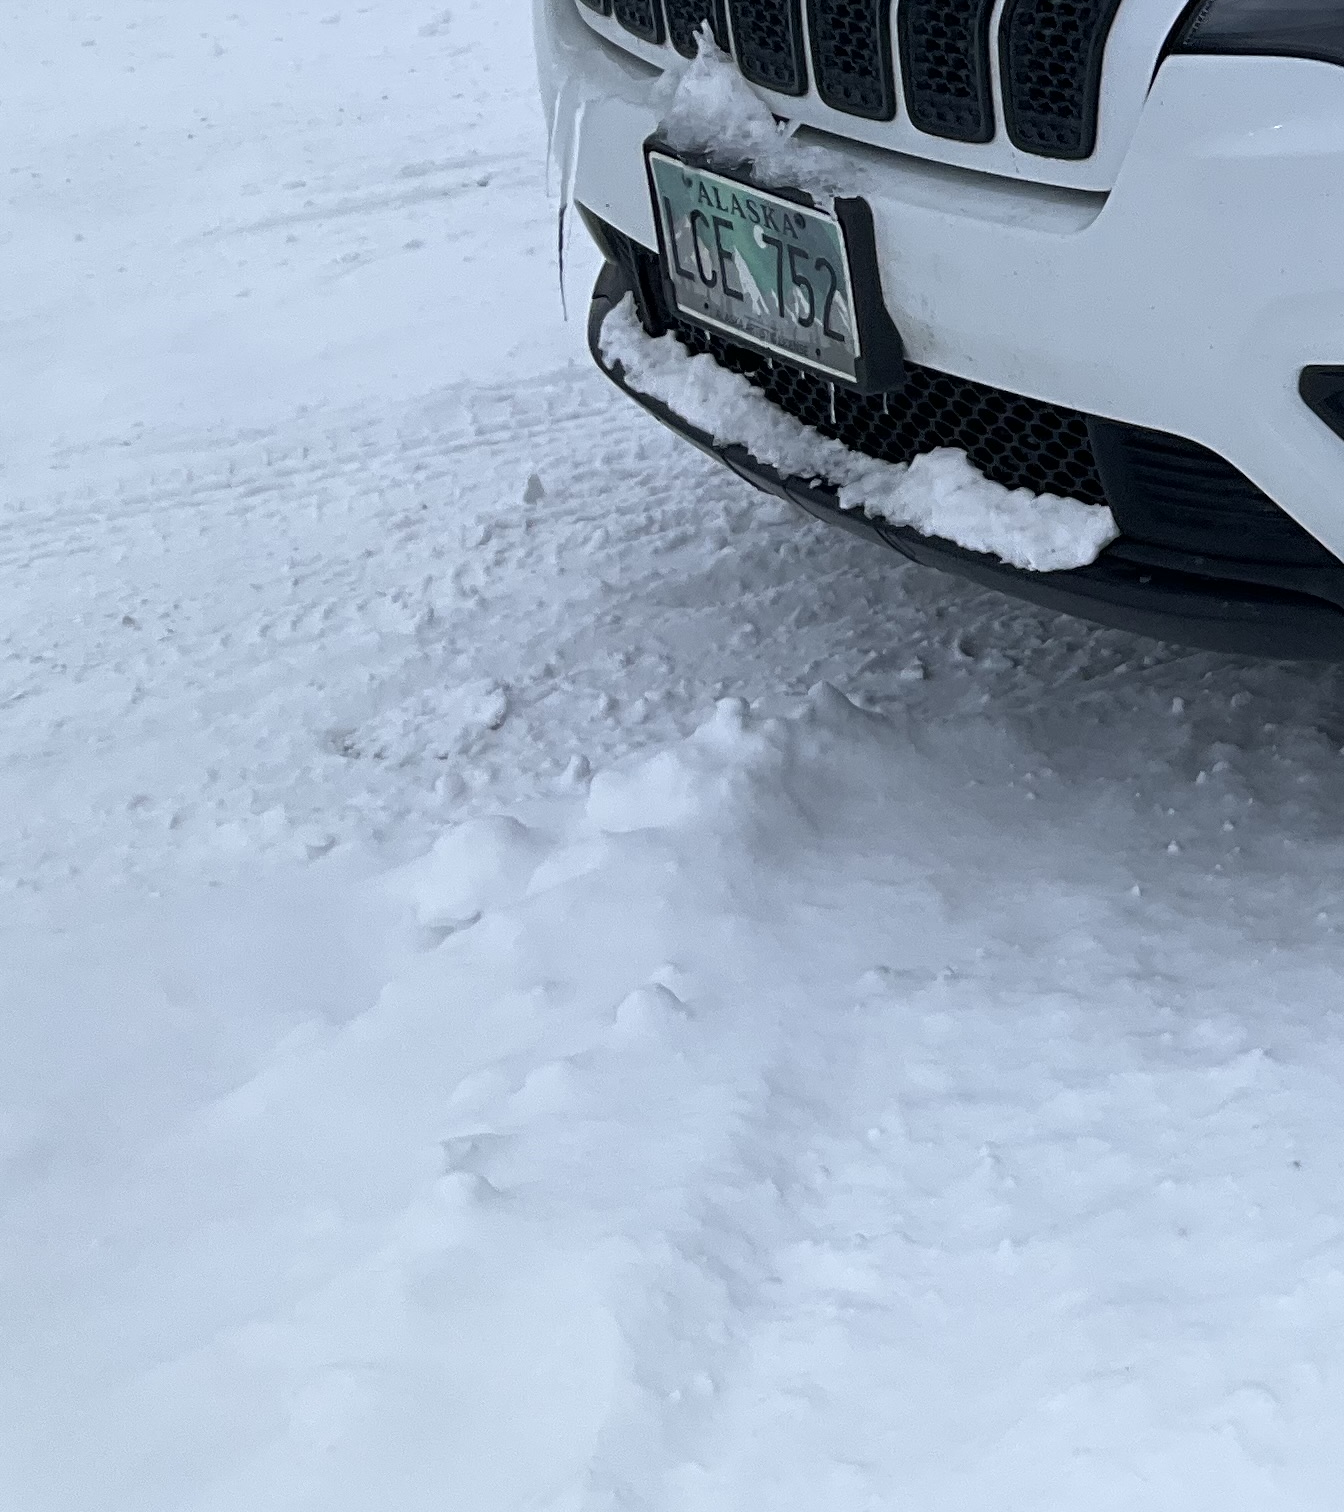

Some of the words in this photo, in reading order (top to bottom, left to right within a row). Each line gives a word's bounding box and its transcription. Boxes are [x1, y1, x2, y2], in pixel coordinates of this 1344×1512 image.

[697, 181, 799, 240] ALASKA
[664, 195, 744, 303] LCE
[761, 233, 845, 342] 752
